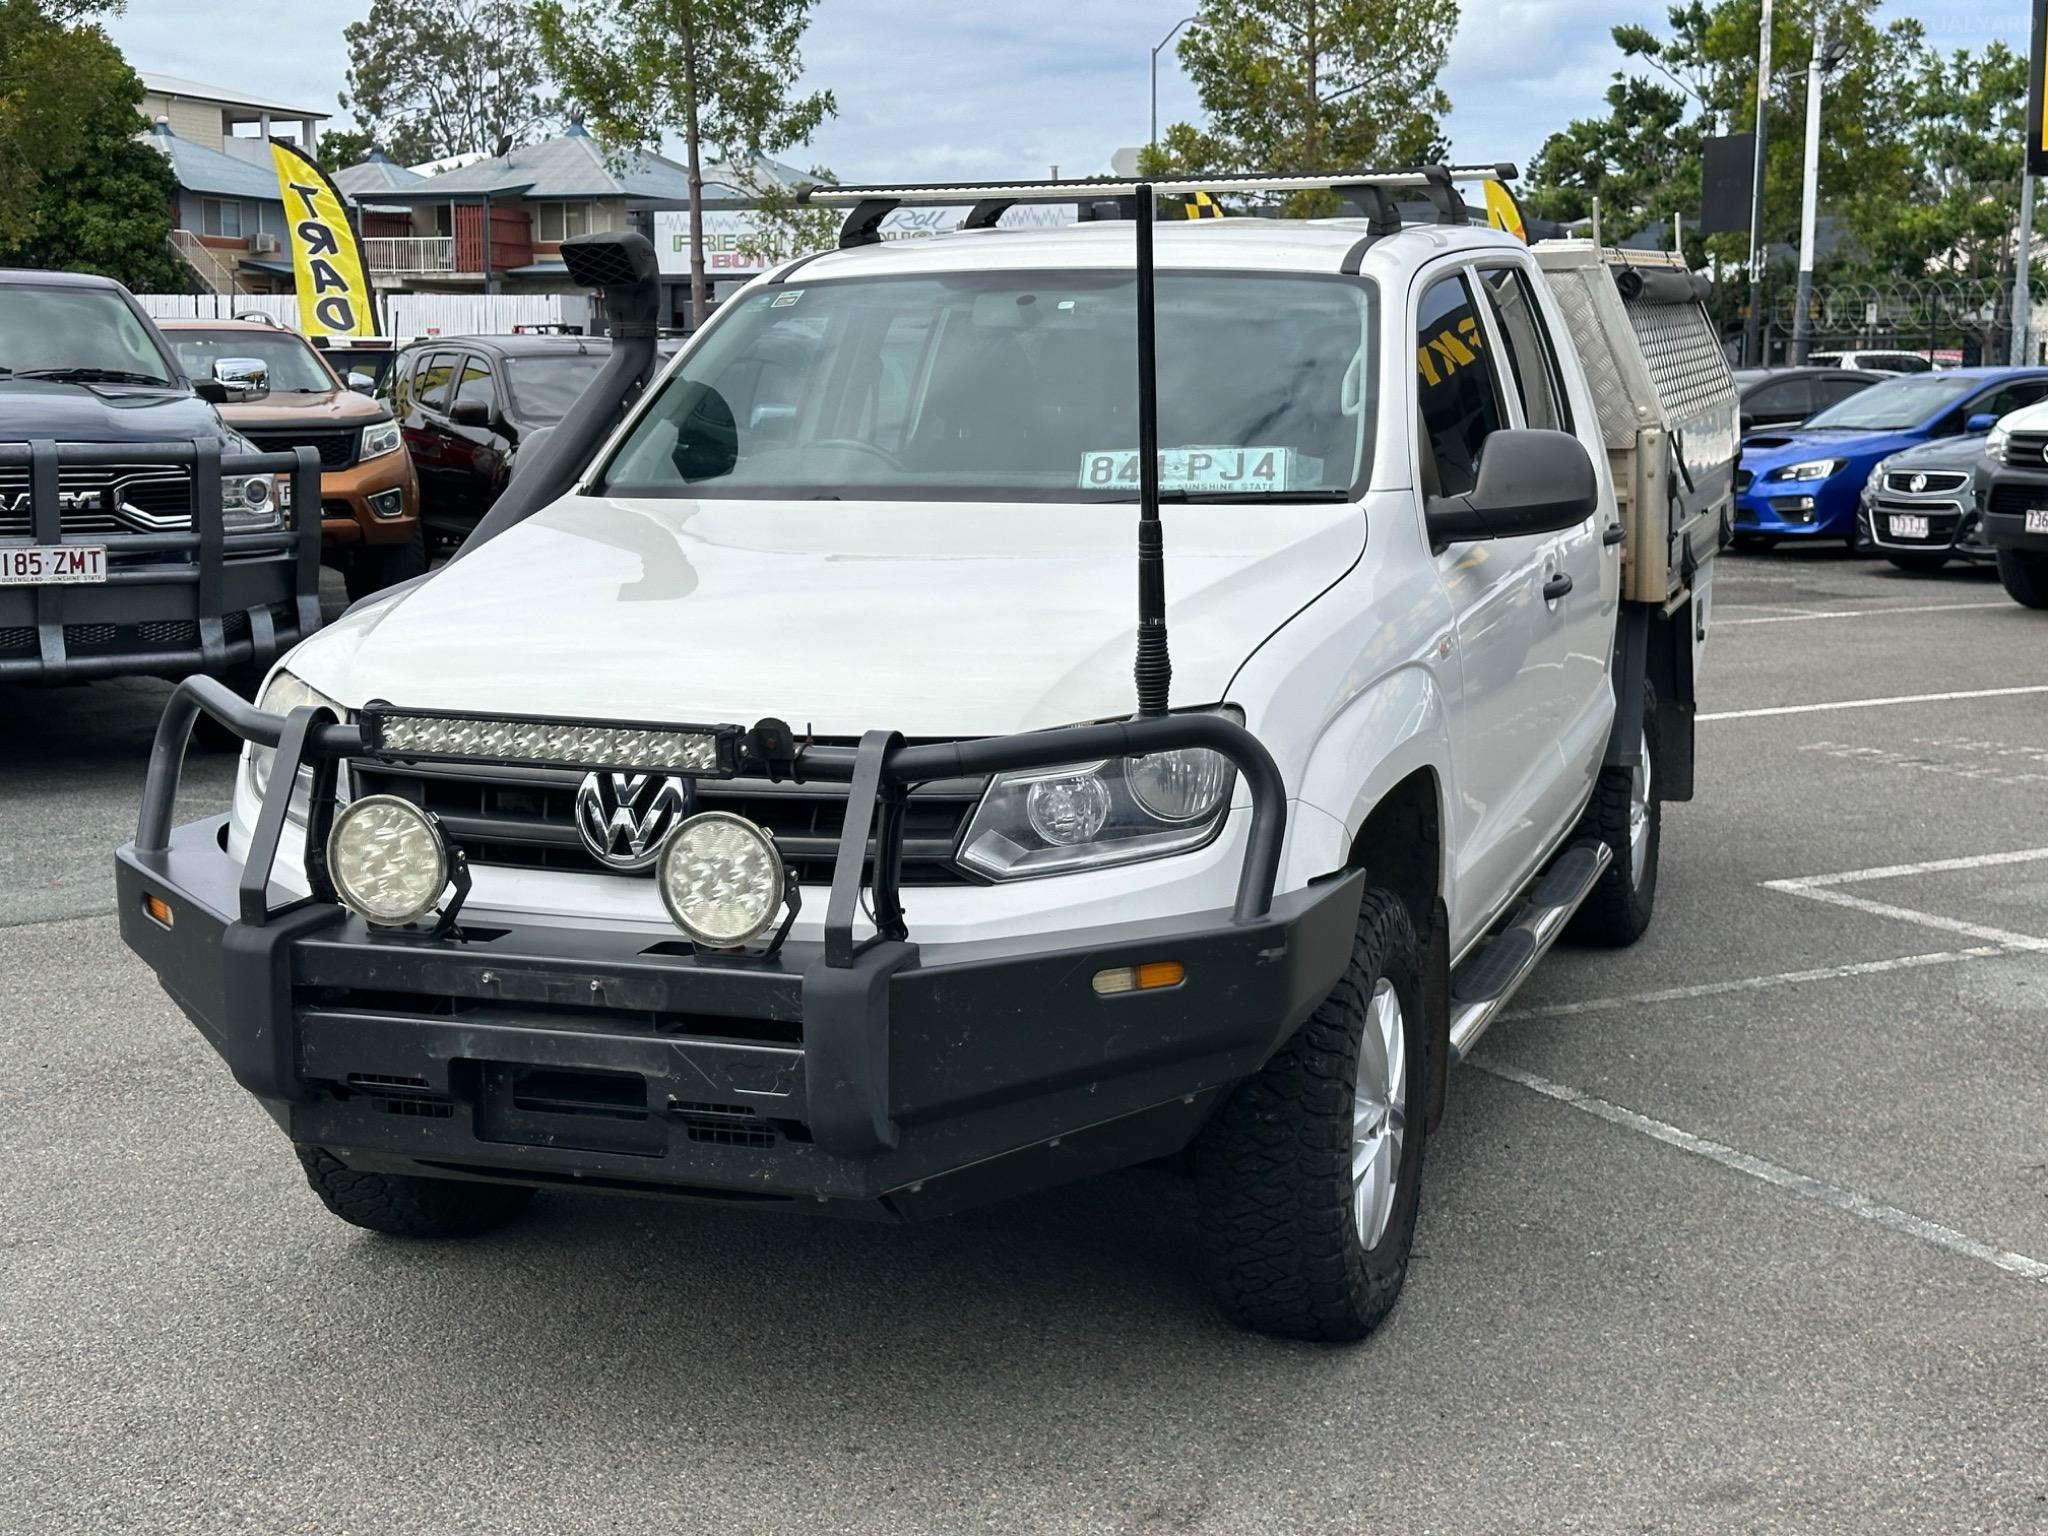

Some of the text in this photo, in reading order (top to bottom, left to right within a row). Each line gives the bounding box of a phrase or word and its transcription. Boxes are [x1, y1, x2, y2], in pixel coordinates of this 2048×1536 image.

[1187, 451, 1276, 482] PJ4
[1177, 483, 1234, 491] SUNSHINE
[1240, 483, 1274, 491] STATE
[53, 550, 101, 575] ZMT
